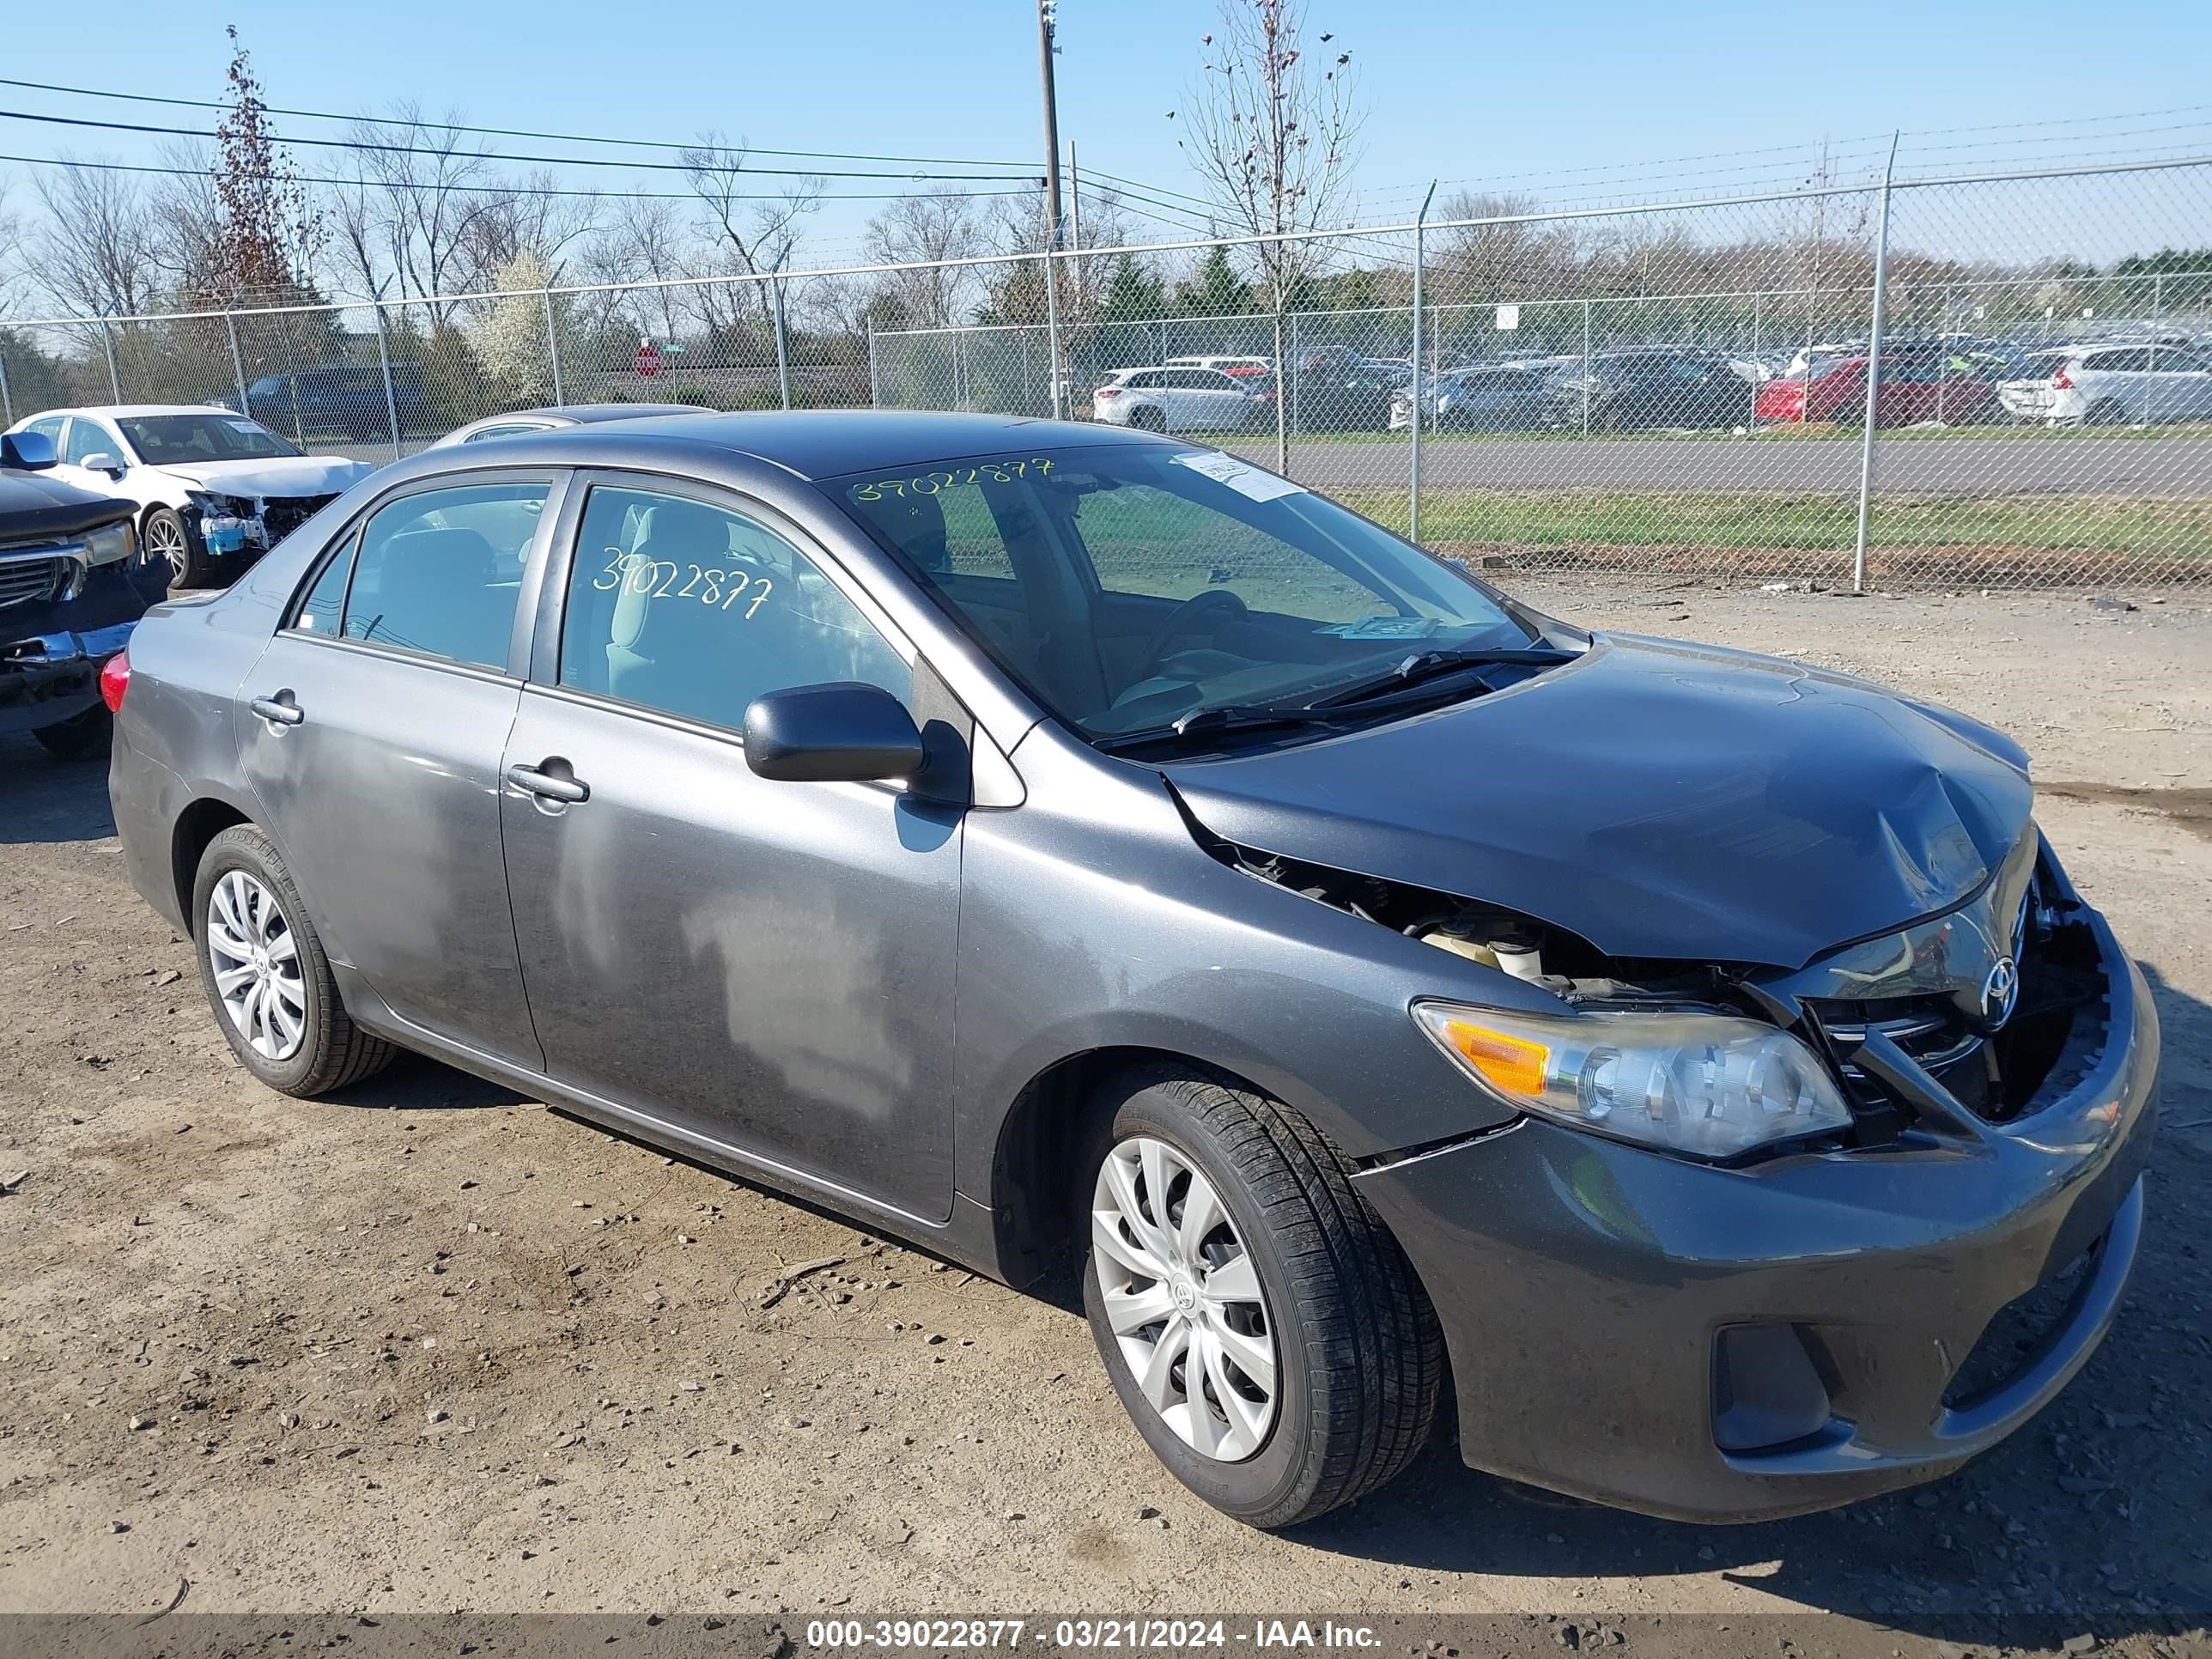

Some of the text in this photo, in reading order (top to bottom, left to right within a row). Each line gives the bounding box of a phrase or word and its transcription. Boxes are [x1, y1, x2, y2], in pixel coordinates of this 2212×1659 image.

[634, 356, 659, 368] STOP
[852, 458, 1055, 501] 39022877
[592, 546, 773, 620] 39022877
